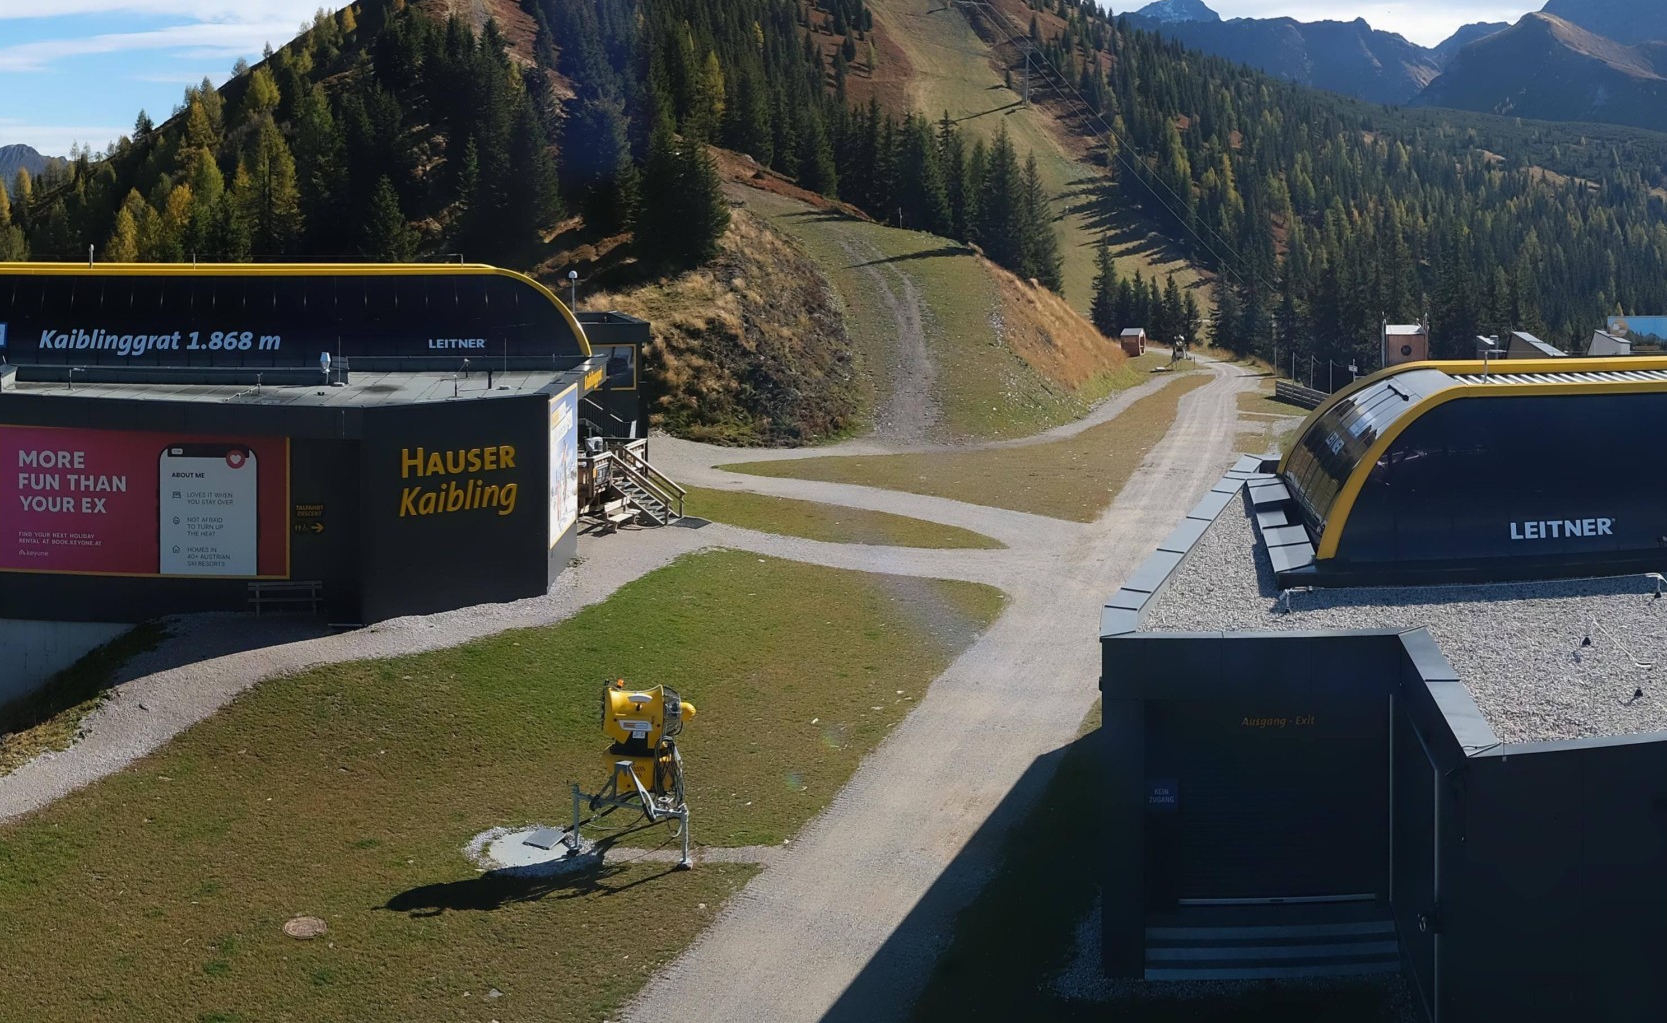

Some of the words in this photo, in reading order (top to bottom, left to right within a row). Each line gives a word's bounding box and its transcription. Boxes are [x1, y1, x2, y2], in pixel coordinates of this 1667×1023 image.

[38, 329, 181, 357] Kaiblinggrat
[186, 331, 253, 351] 1.868
[258, 334, 282, 351] m
[428, 338, 486, 349] LEITNER
[18, 449, 85, 469] MORE
[401, 445, 516, 479] HAUSER
[18, 473, 60, 491] FUN
[66, 474, 127, 492] THAN
[19, 495, 75, 513] YOUR
[81, 497, 107, 514] EX
[399, 479, 518, 517] Kaibling
[1510, 518, 1613, 540] LEITNER
[27, 549, 49, 557] keyone
[1241, 716, 1287, 729] Ausgang
[1295, 715, 1315, 725] Exit
